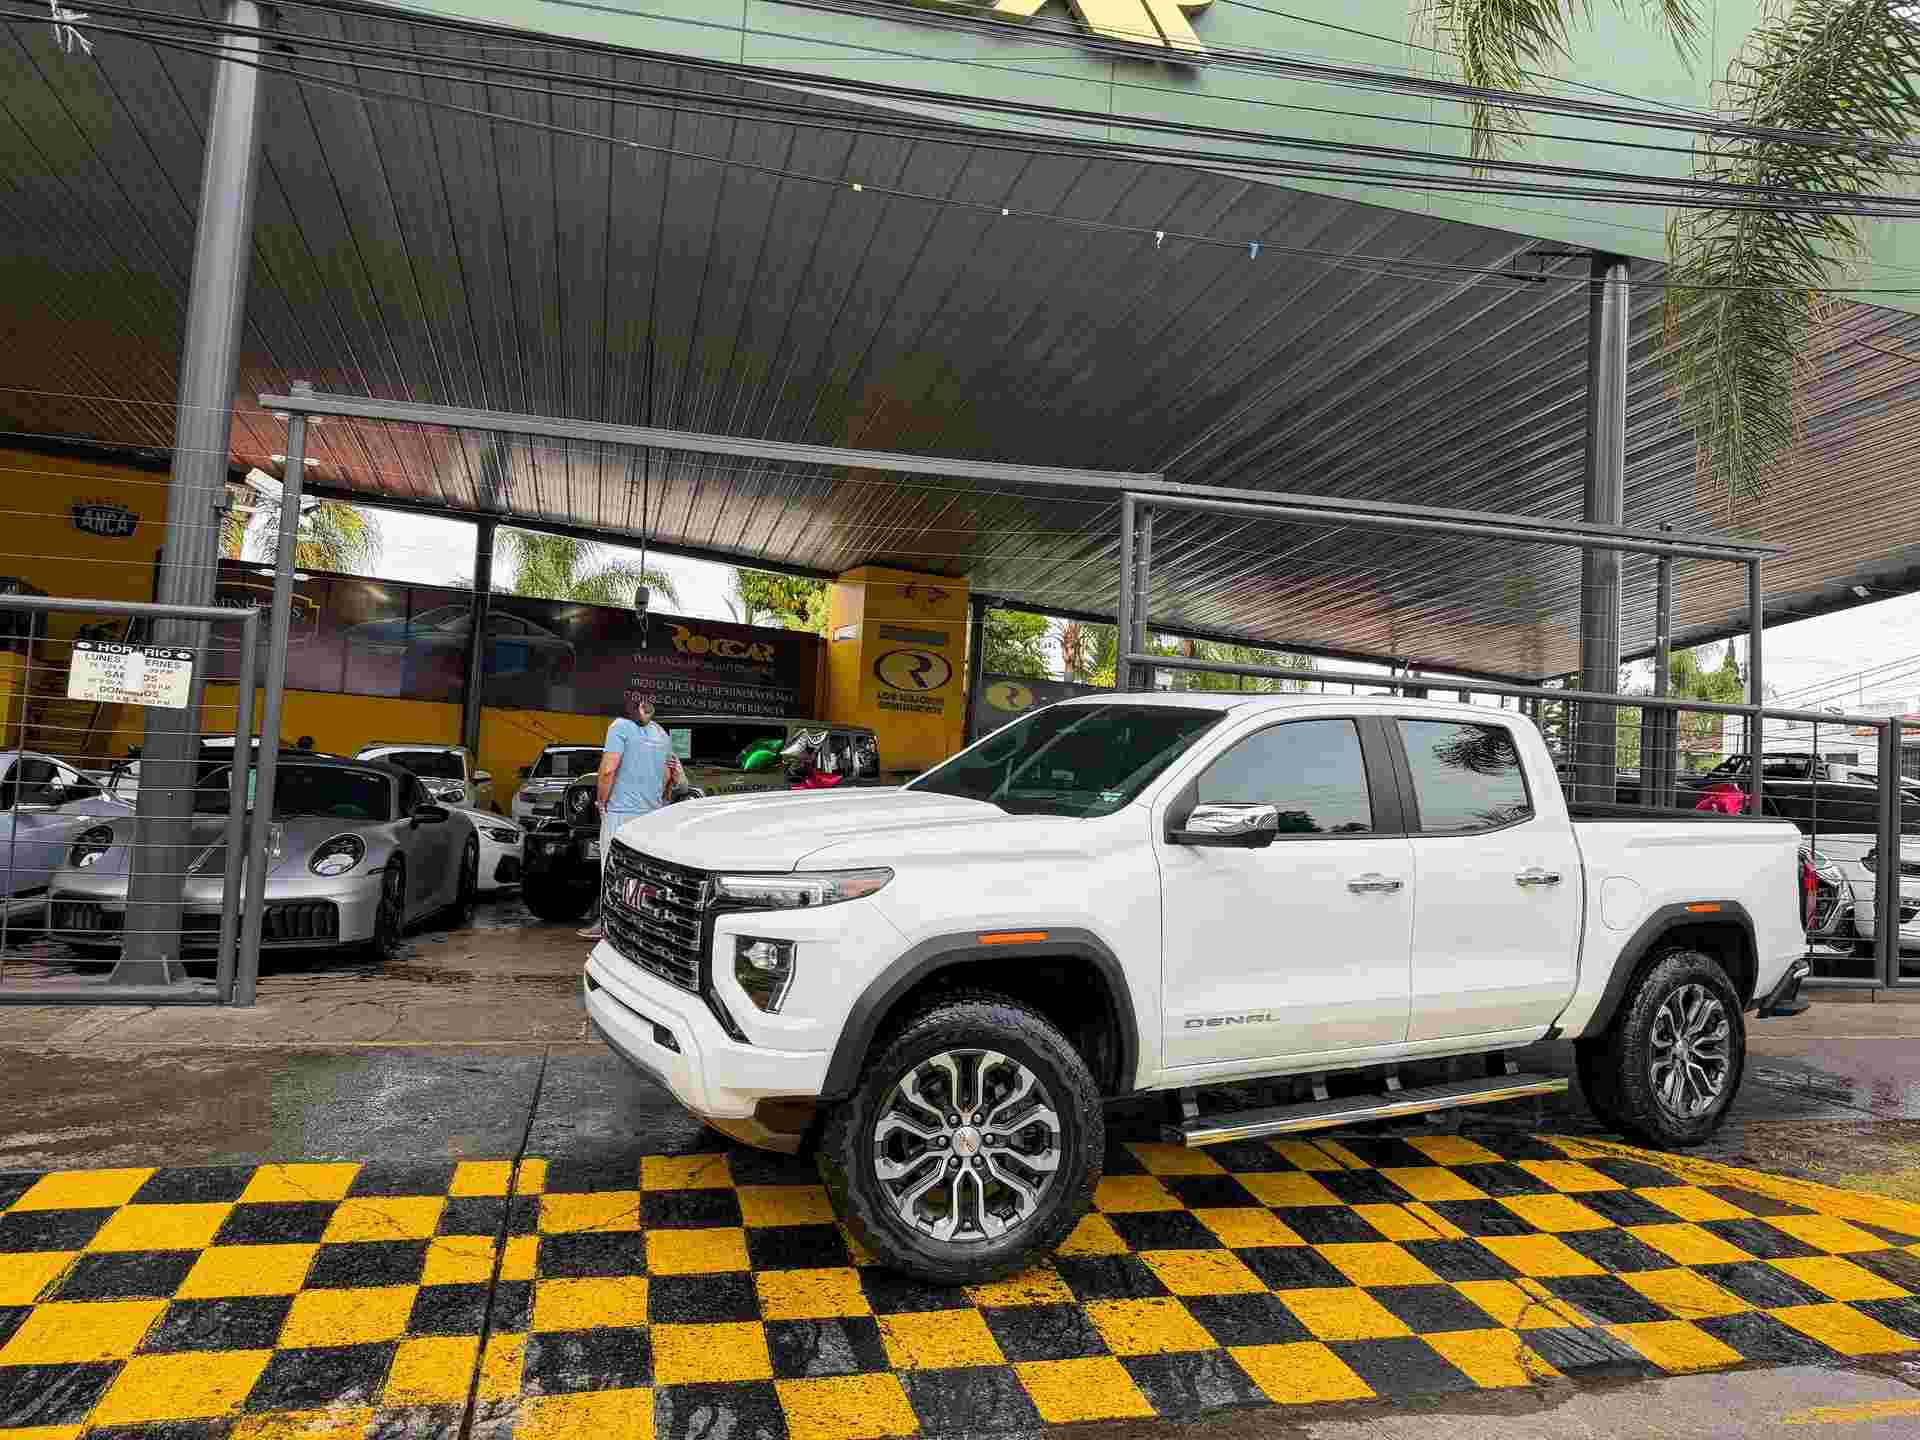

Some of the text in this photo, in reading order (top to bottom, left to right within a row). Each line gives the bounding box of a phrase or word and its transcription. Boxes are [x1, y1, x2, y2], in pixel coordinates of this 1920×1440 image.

[97, 643, 173, 658] HORRIO
[84, 653, 121, 664] LUNES
[144, 658, 182, 670] ERNES
[1184, 1012, 1282, 1028] DENAL
